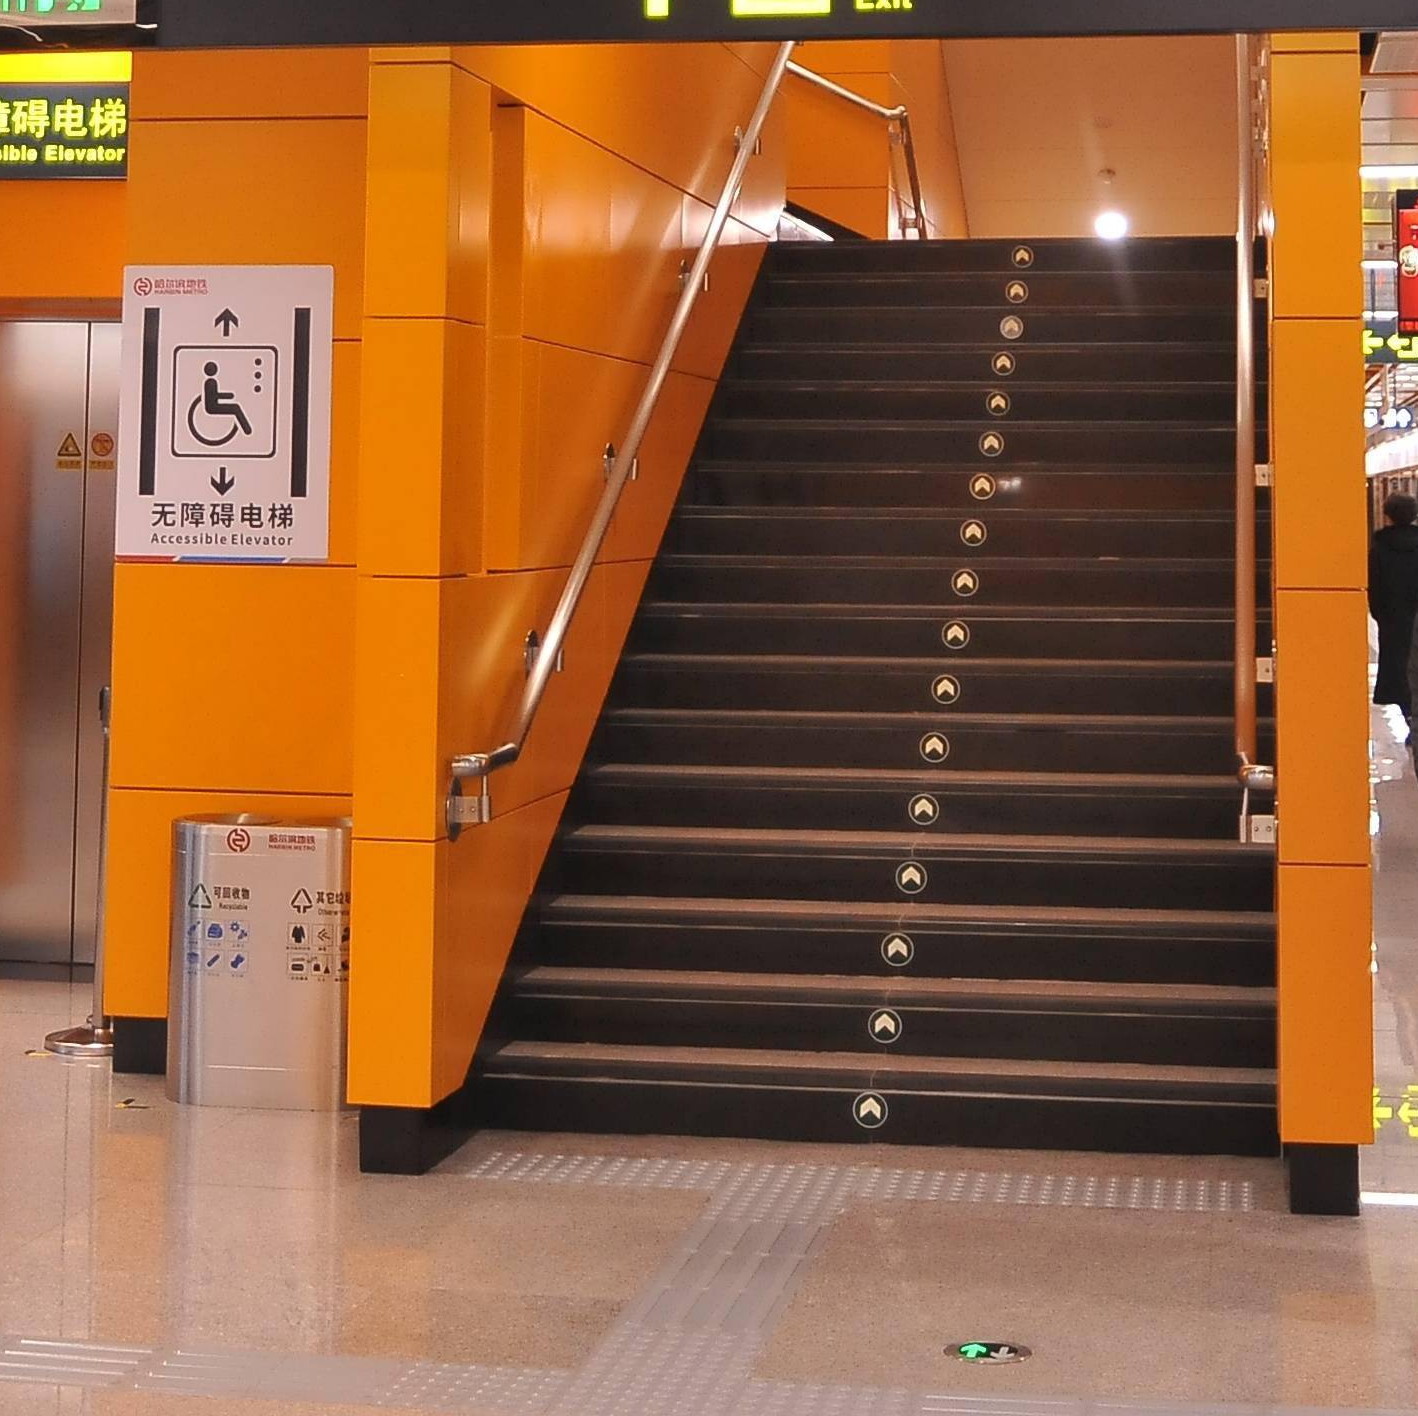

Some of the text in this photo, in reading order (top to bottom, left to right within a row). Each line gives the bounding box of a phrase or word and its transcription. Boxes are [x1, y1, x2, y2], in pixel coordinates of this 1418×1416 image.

[44, 145, 126, 162] Elevator
[151, 502, 294, 529] 无障碍电梯
[151, 533, 294, 547] Accessible Elevator
[213, 886, 250, 900] 可回收物
